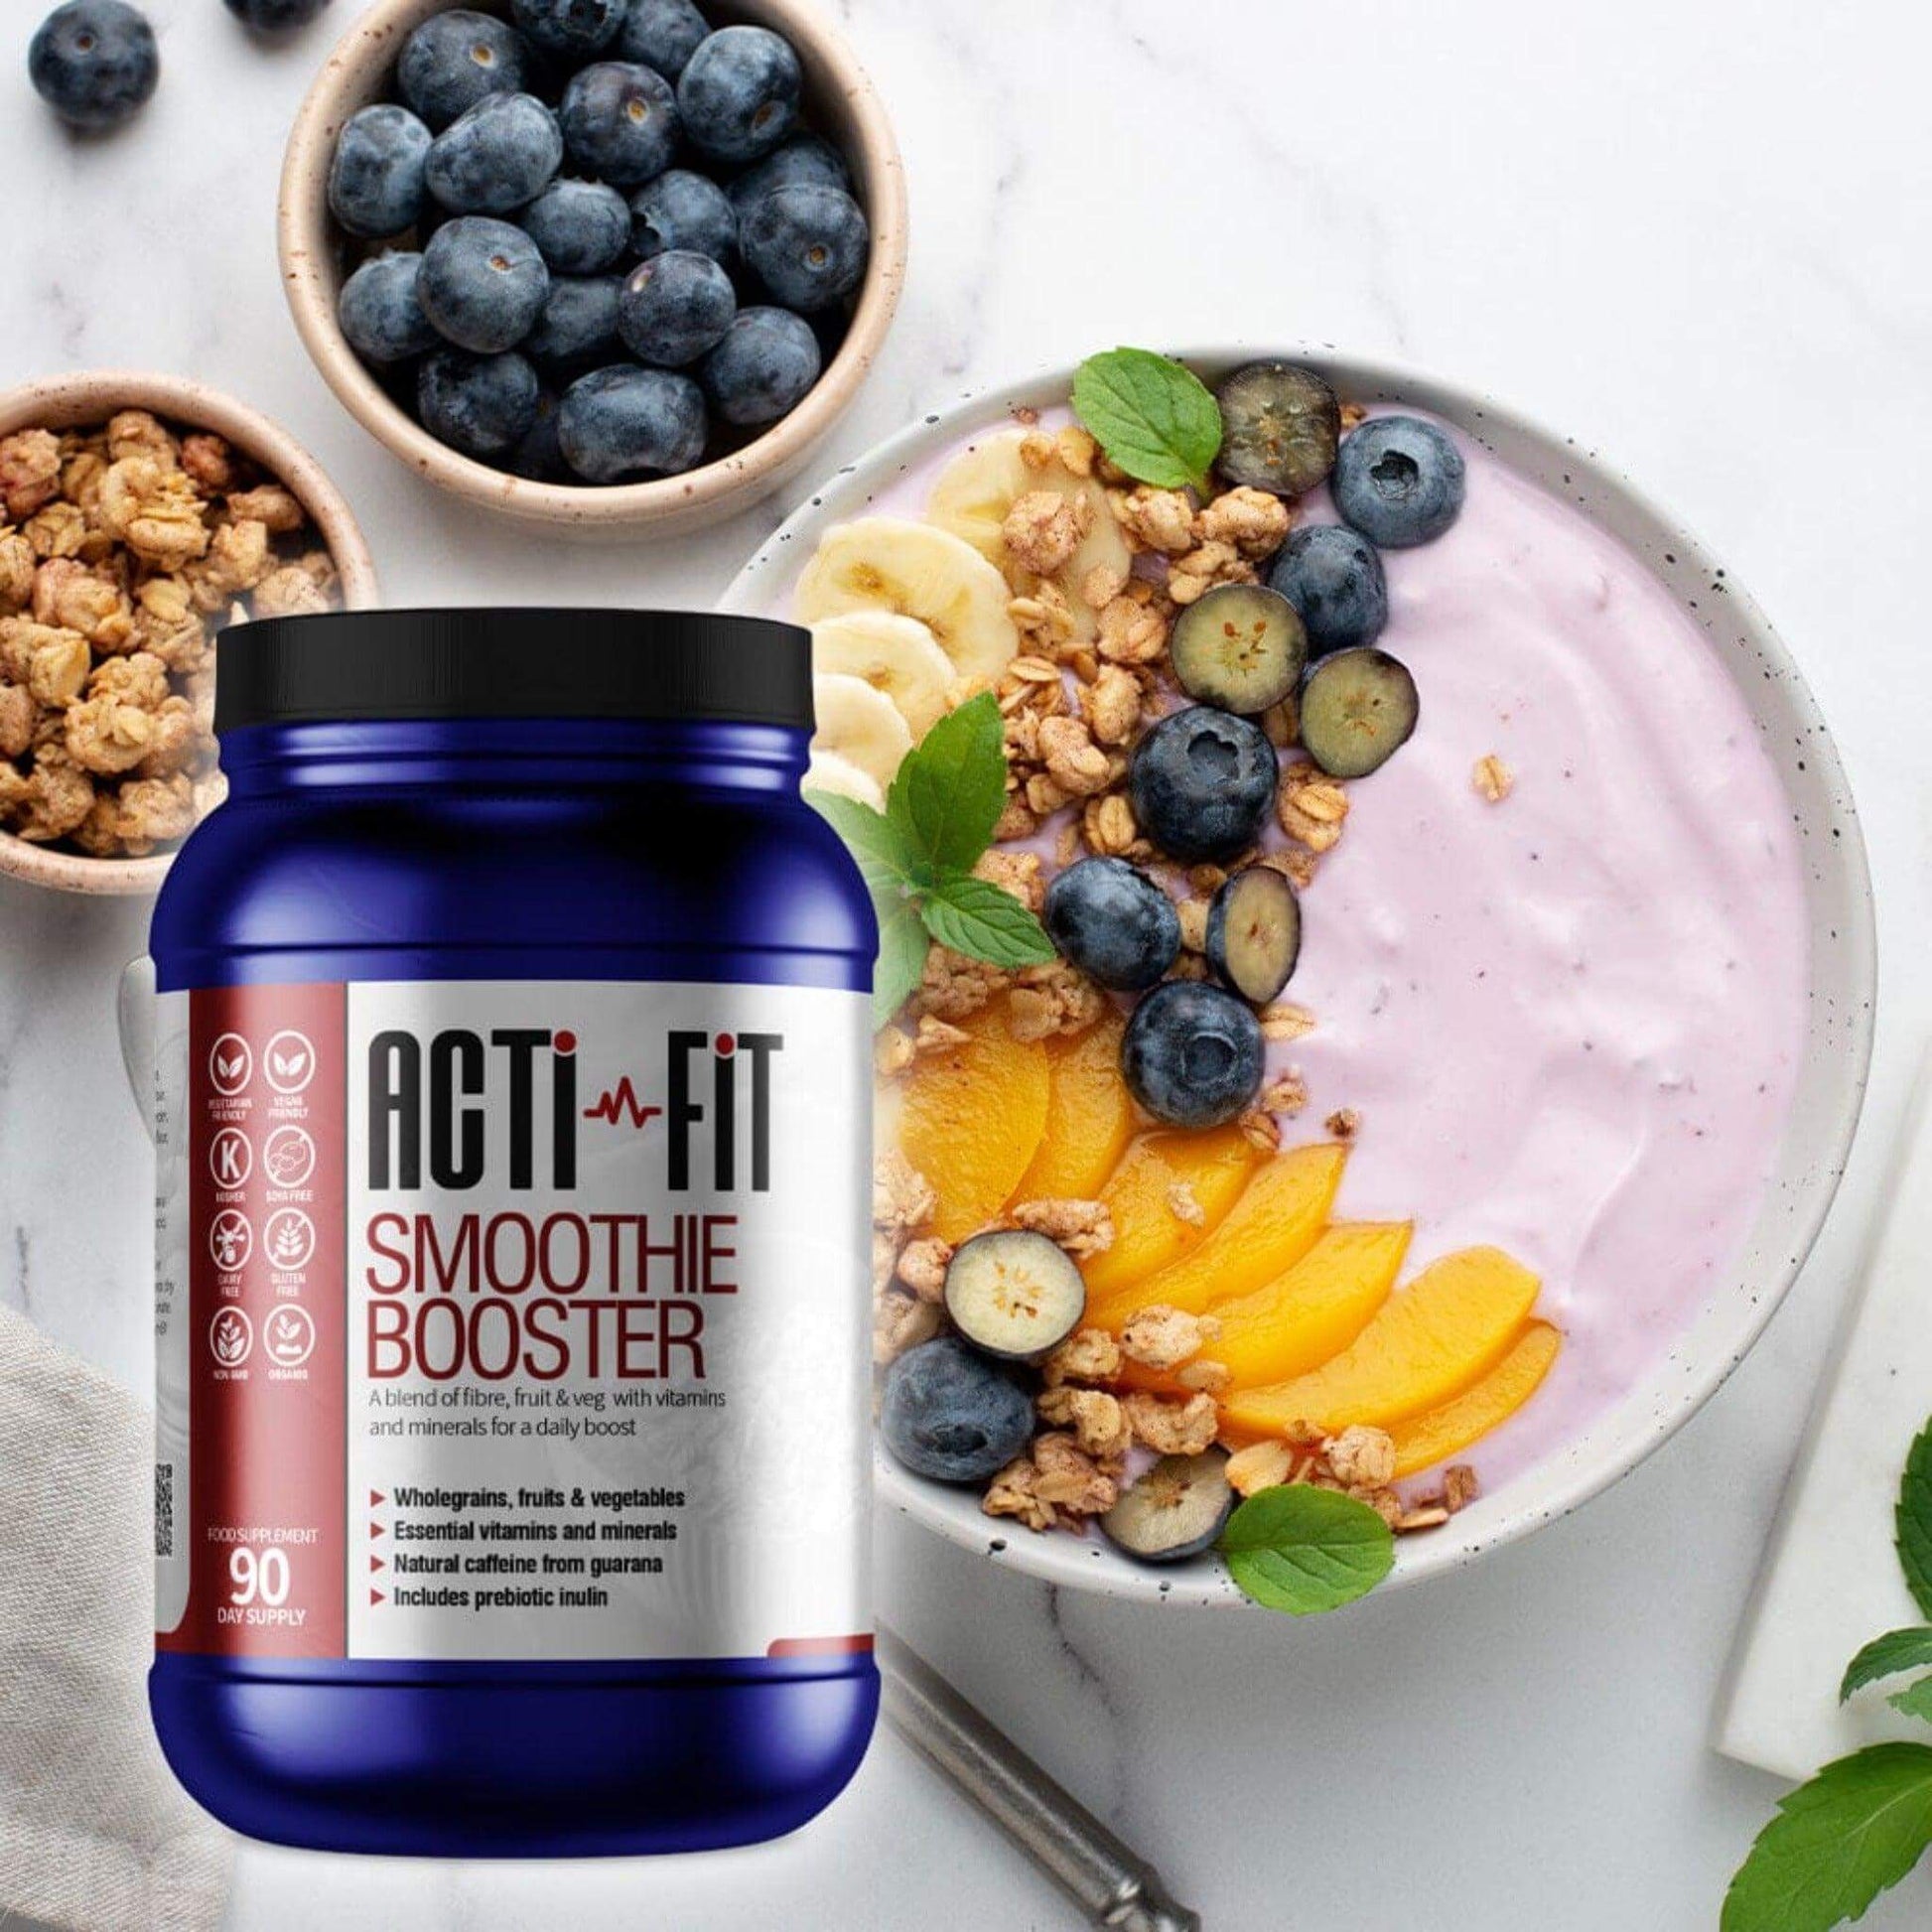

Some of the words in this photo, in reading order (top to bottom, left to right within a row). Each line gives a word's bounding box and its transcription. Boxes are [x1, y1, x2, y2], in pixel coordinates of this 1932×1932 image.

[366, 1212, 739, 1295] SMOOTHIE
[367, 1299, 707, 1380] BOOSTER
[368, 1389, 381, 1407] A
[385, 1388, 438, 1407] blend
[441, 1387, 462, 1407] of
[462, 1387, 511, 1410] fibre,
[514, 1387, 551, 1407] fruit
[555, 1389, 570, 1407] &
[573, 1392, 606, 1411] veg
[614, 1387, 652, 1407] with
[656, 1387, 726, 1407] vitamins
[369, 1418, 404, 1437] and
[408, 1417, 487, 1437] minerals
[491, 1417, 516, 1437] for
[520, 1421, 532, 1437] a
[536, 1417, 580, 1441] daily
[585, 1417, 636, 1437] boost
[394, 1488, 513, 1512] Wholegrains,
[517, 1487, 566, 1508] fruits
[570, 1489, 585, 1507] &
[590, 1488, 685, 1512] vegetables
[207, 1527, 238, 1543] FOOD
[237, 1527, 320, 1545] SUPPLEMENT
[394, 1520, 475, 1541] Essential
[479, 1520, 557, 1541] vitamins
[562, 1520, 596, 1541] and
[601, 1520, 677, 1541] minerals
[229, 1546, 290, 1606] 90
[394, 1554, 460, 1574] Natural
[465, 1554, 537, 1574] caffeine
[542, 1554, 585, 1574] from
[590, 1558, 663, 1579] guarana
[394, 1586, 470, 1607] Includes
[475, 1586, 554, 1611] prebiotic
[559, 1586, 609, 1607] inulin
[217, 1607, 244, 1623] DAY
[246, 1608, 307, 1625] SUPPLY
